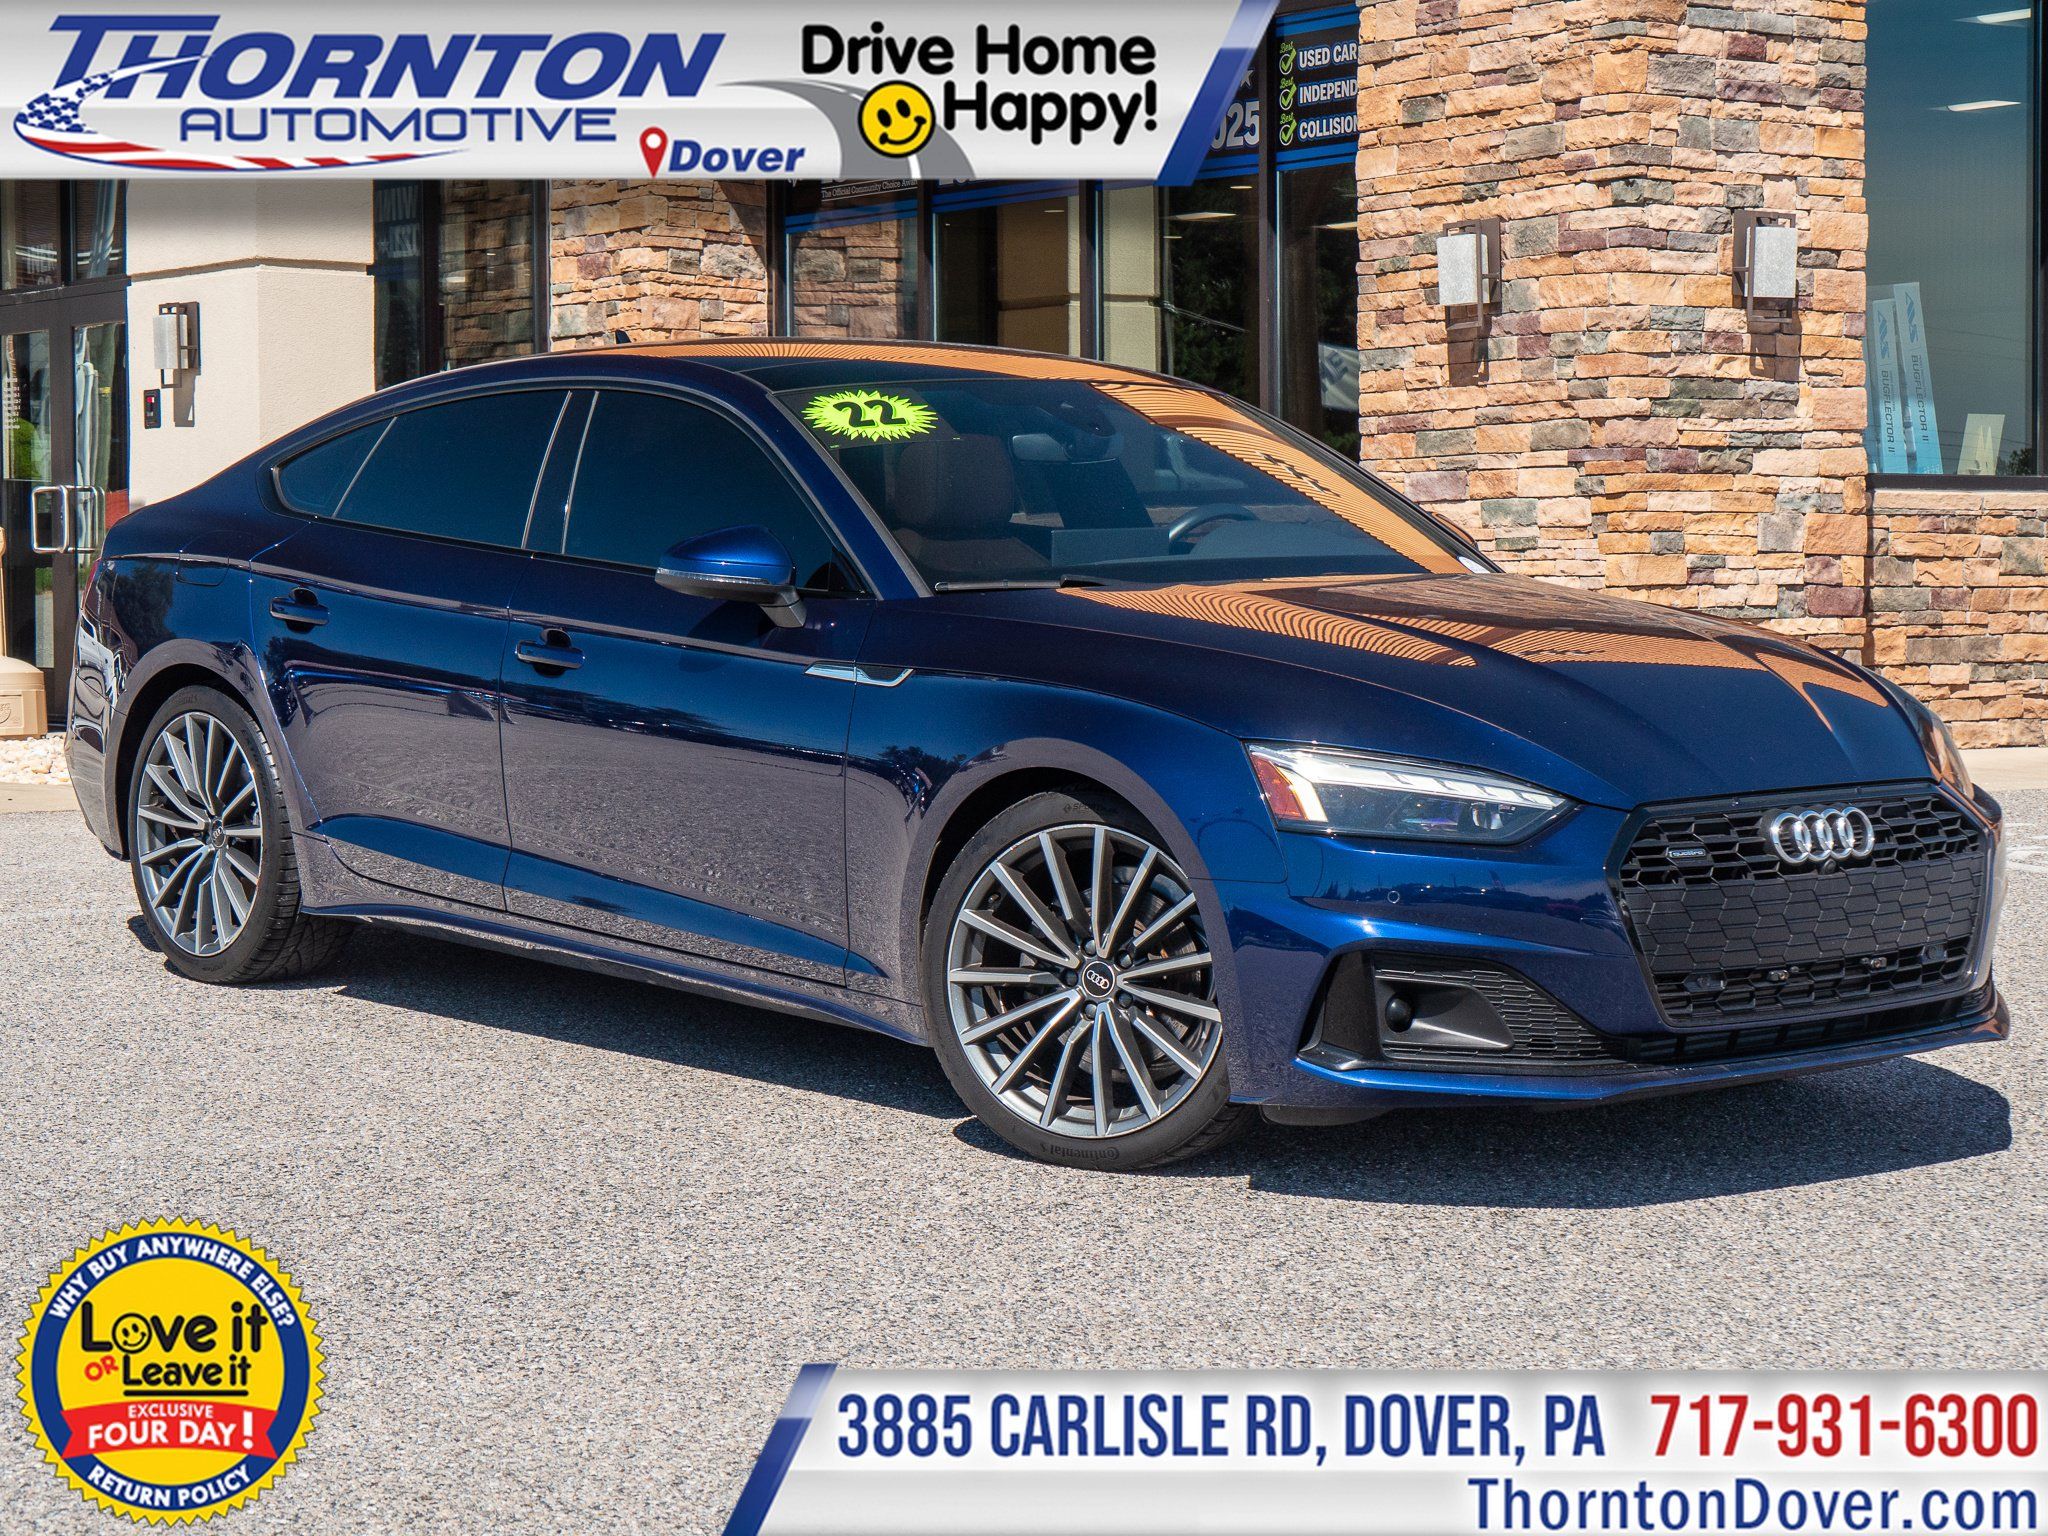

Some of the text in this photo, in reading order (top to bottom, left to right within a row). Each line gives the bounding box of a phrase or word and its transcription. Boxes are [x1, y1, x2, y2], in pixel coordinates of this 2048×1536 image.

[1299, 48, 1330, 69] USED
[1299, 79, 1357, 104] INDEPEND
[851, 183, 882, 195] Community
[882, 180, 901, 191] Choice
[1911, 354, 1928, 431] BUGFLECTOR
[832, 399, 907, 427] 22
[1881, 370, 1894, 443] BUGFLECTOR
